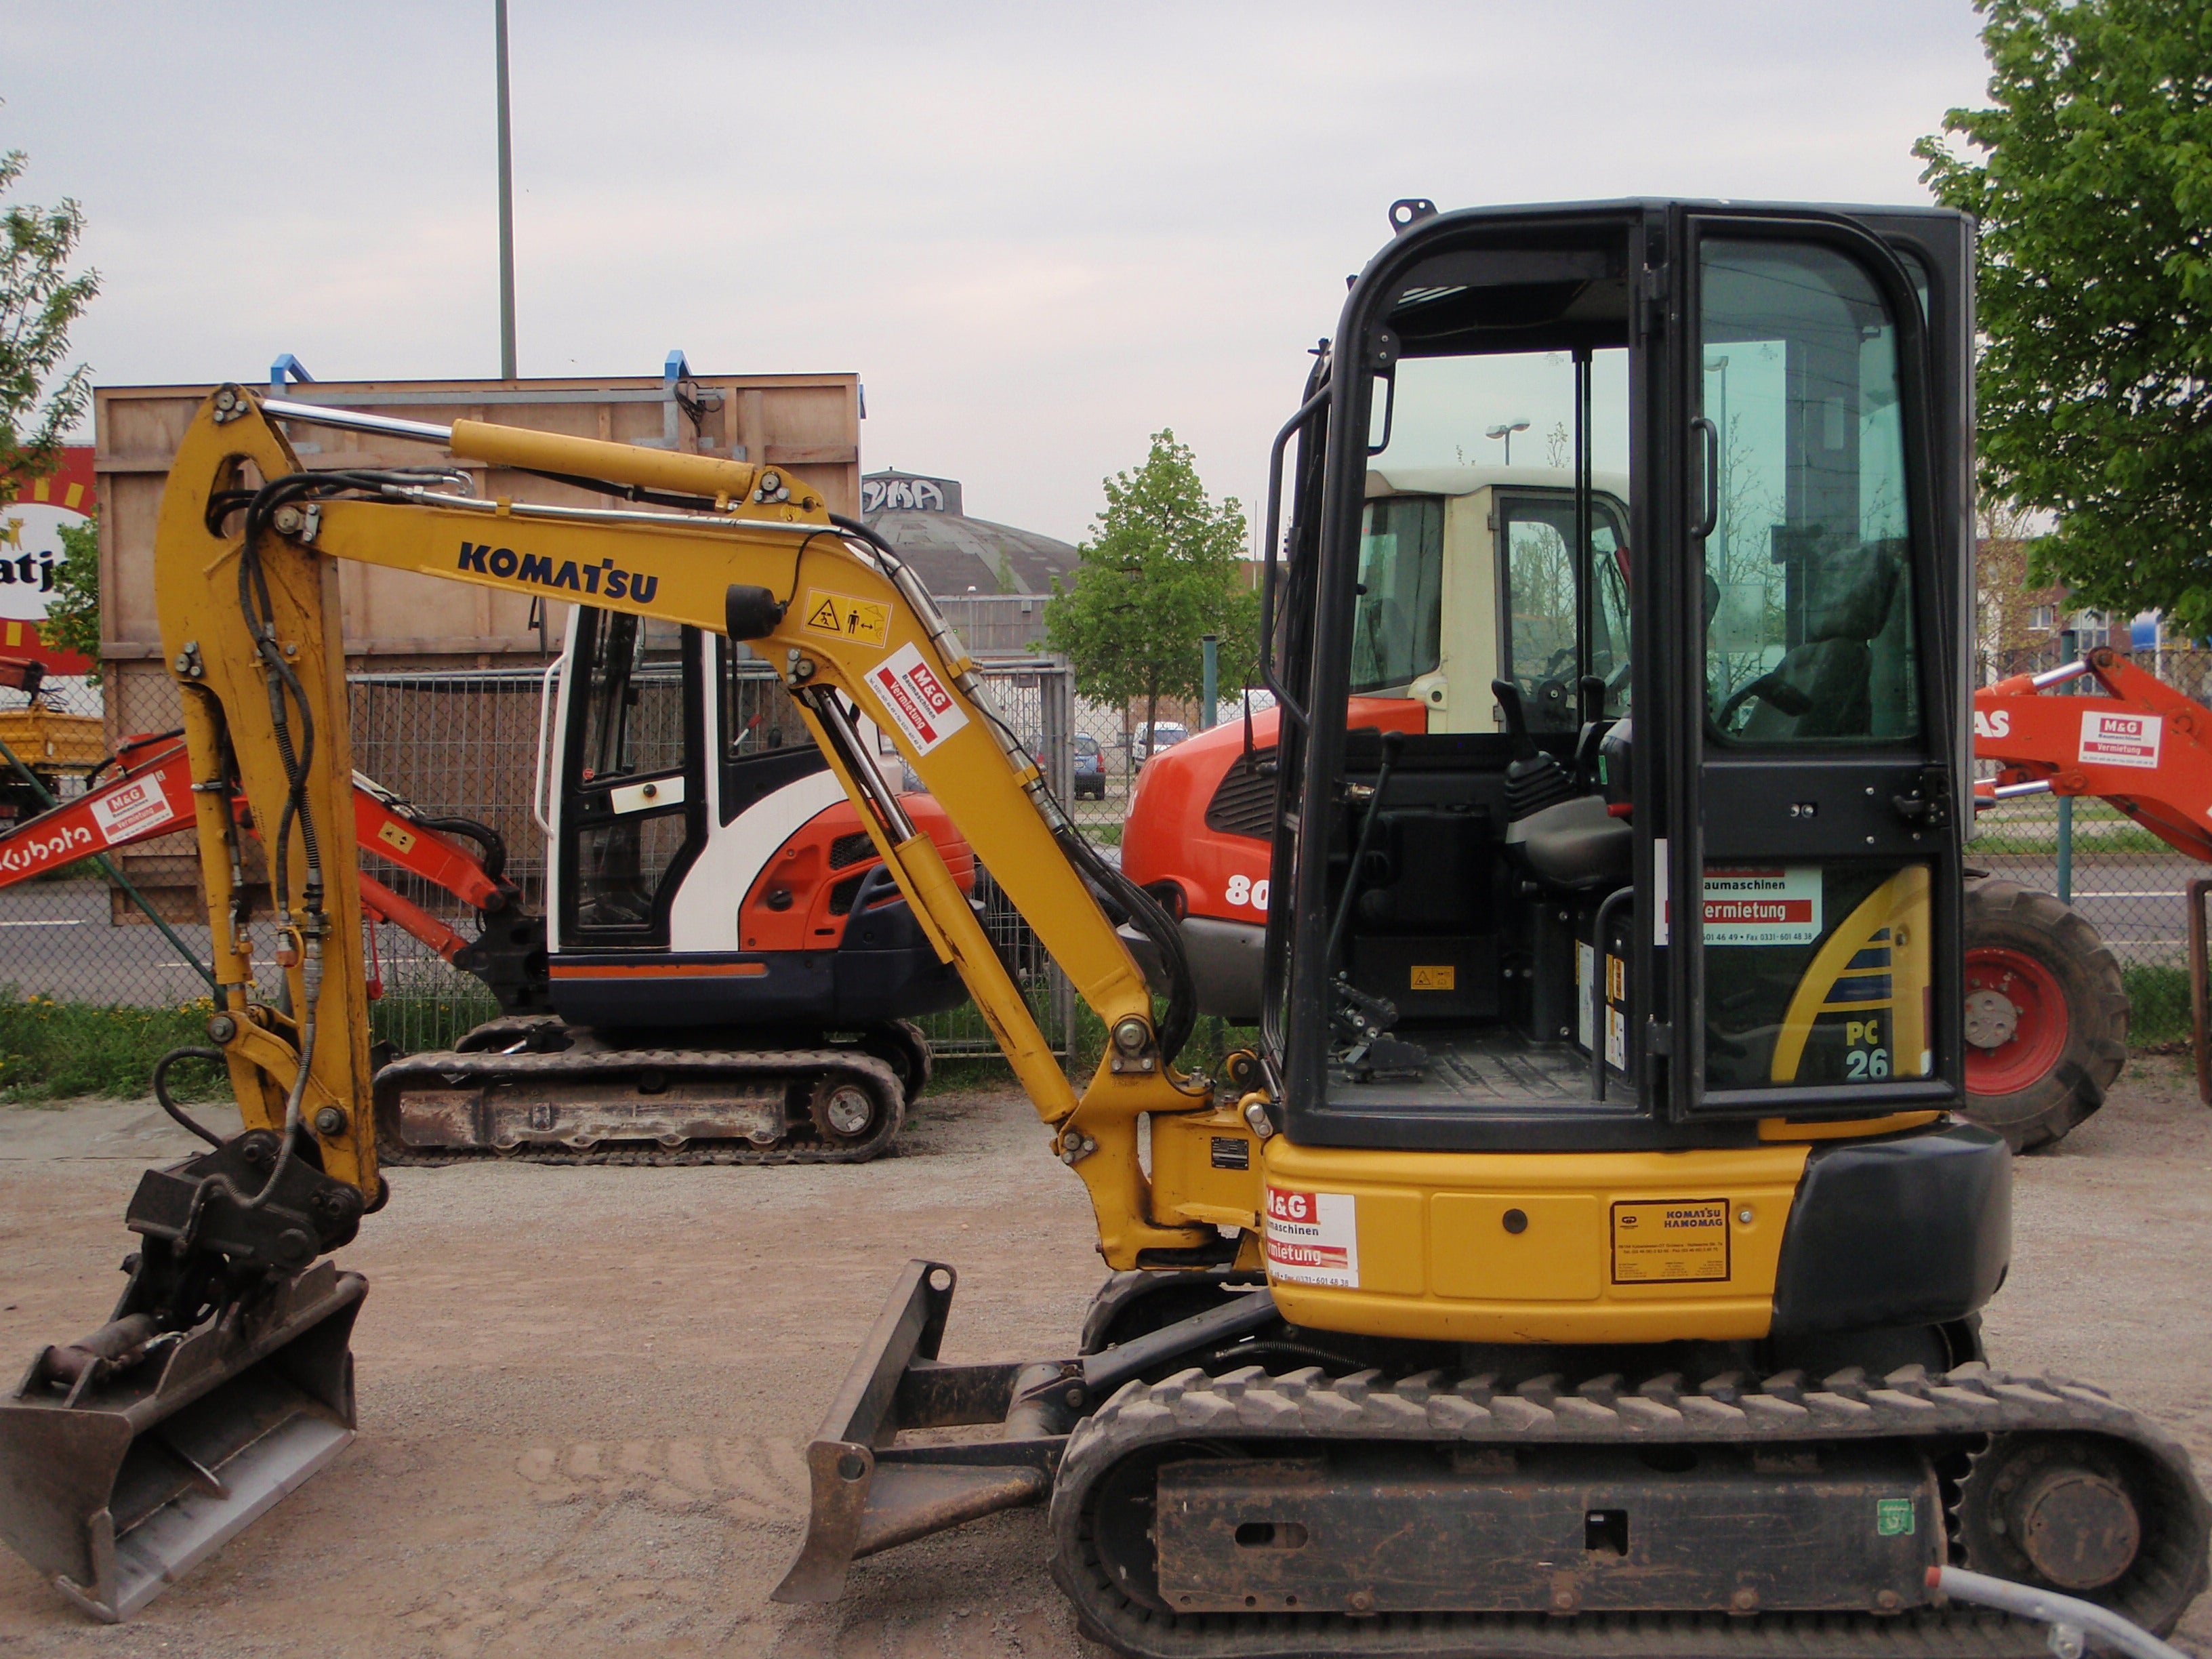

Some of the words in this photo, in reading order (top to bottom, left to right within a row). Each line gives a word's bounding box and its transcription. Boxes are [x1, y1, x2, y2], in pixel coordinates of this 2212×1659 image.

[457, 541, 659, 604] KOMATSU
[901, 673, 937, 720] Baumaschinen
[914, 668, 946, 708] M&G
[890, 680, 926, 730] Vermietung
[1974, 710, 2010, 738] AS
[2104, 719, 2137, 733] M&G
[2097, 743, 2141, 756] Vermietung
[111, 788, 140, 810] M&G
[0, 826, 92, 872] Kubota
[1704, 879, 1786, 890] aumaschinen
[1703, 901, 1786, 922] ermietung
[1845, 1019, 1879, 1046] PC
[1845, 1048, 1889, 1081] 26
[1266, 1189, 1307, 1218] M&G
[1666, 1207, 1721, 1218] KOMATSU
[1664, 1218, 1723, 1228] HANOMAG
